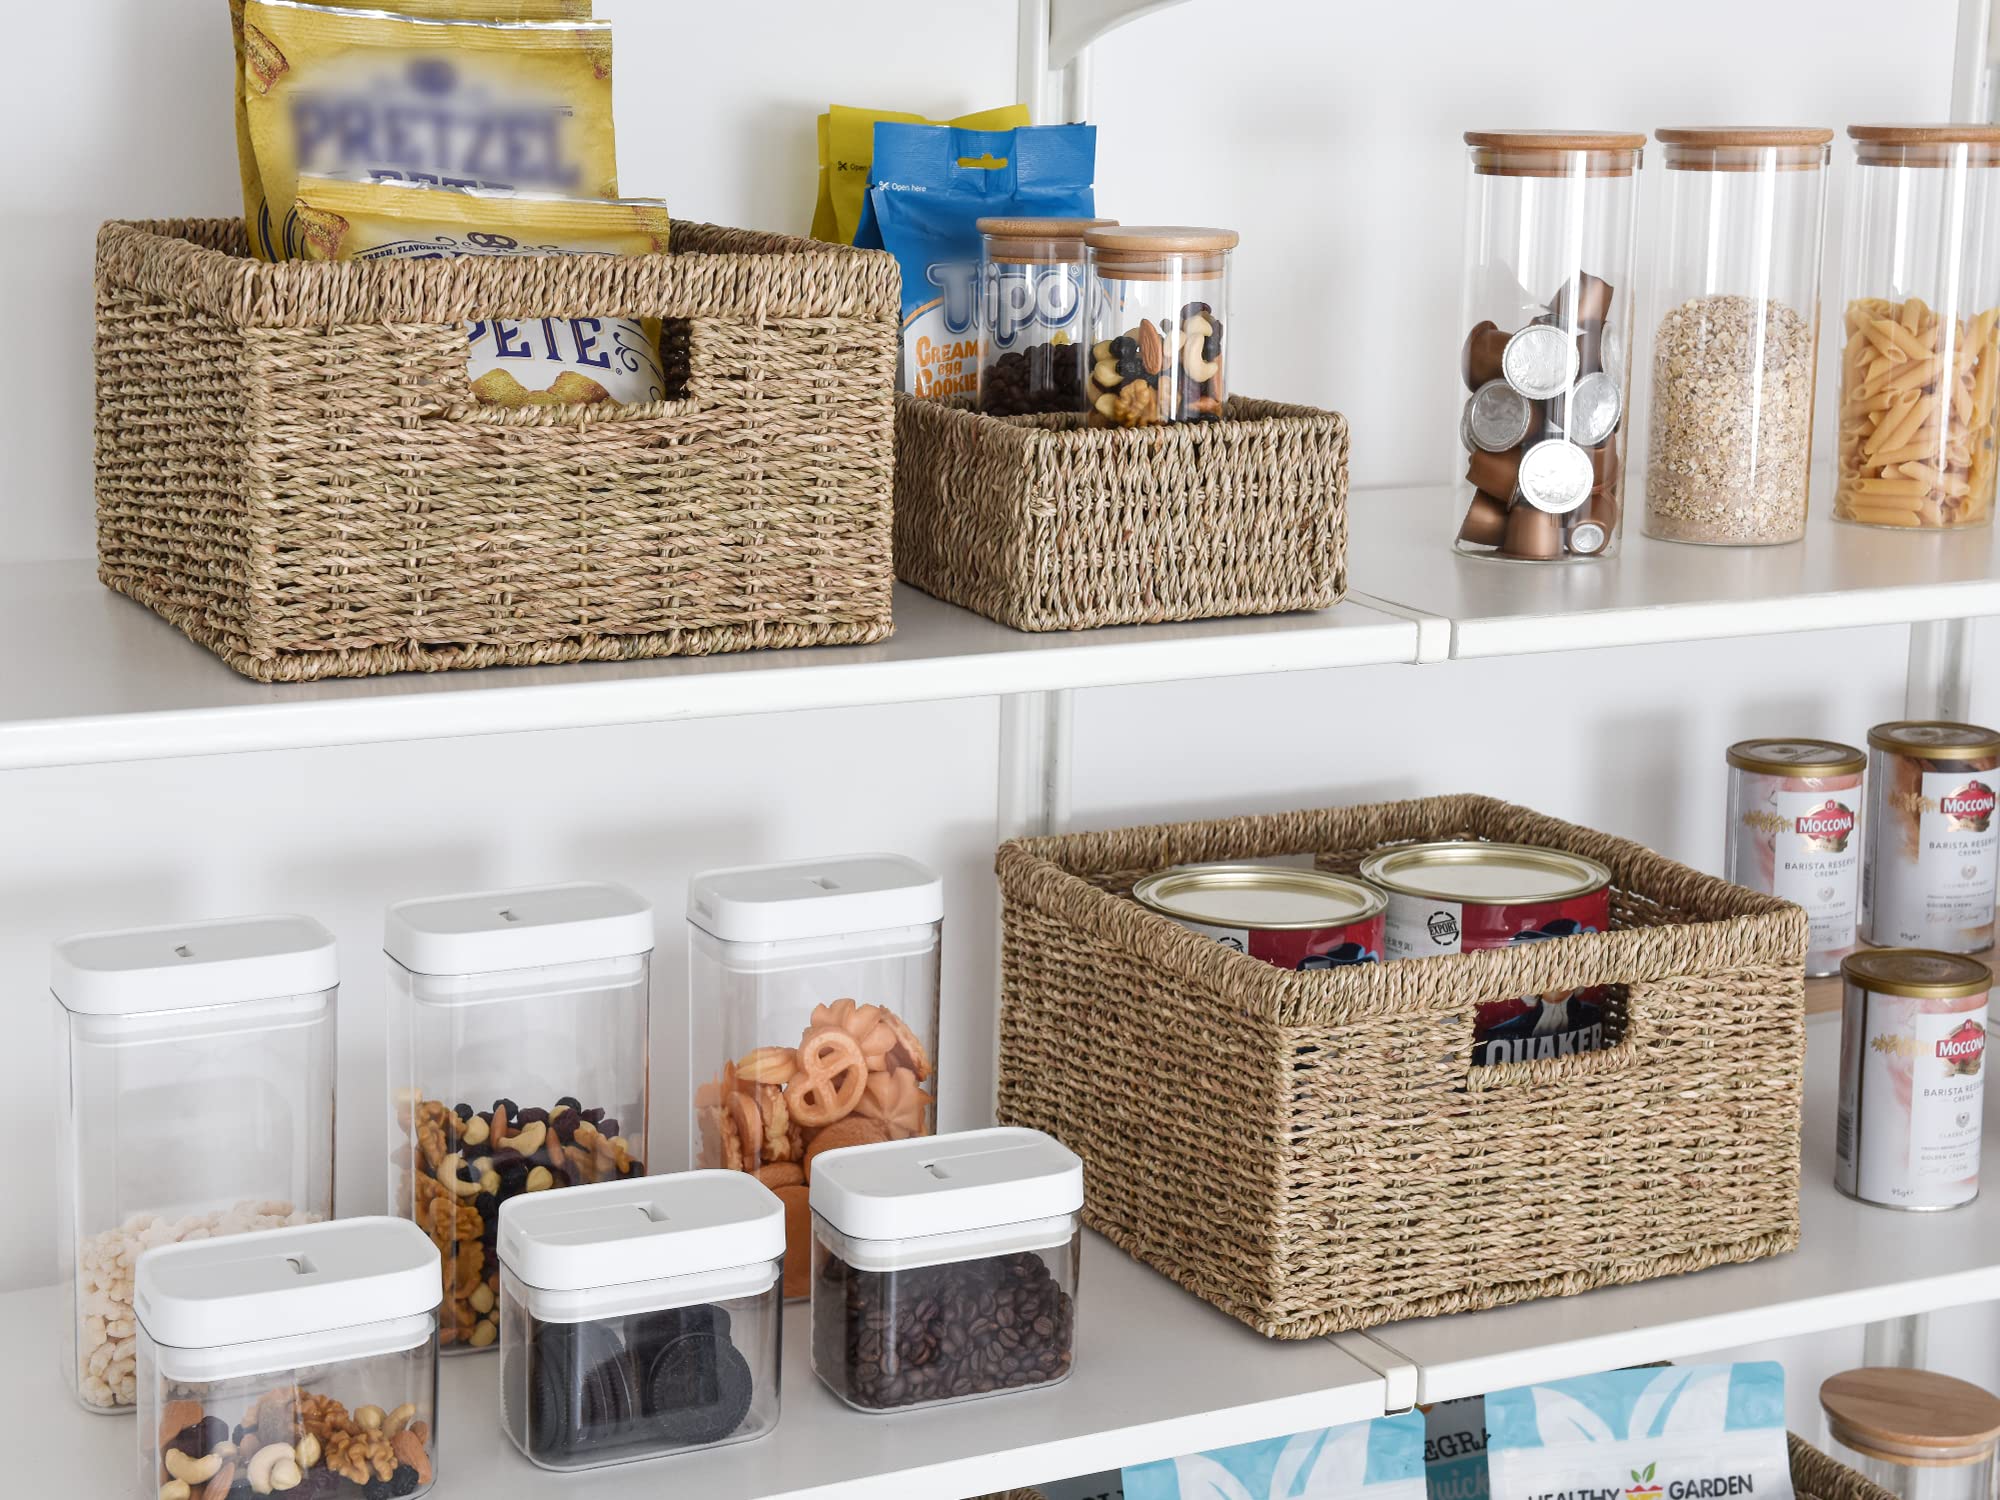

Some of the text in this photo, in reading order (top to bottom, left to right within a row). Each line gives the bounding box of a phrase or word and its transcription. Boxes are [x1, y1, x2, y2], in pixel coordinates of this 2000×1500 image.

[891, 182, 927, 192] Open here
[926, 262, 1081, 349] Tipo
[1799, 815, 1852, 834] MOCCONA
[1928, 840, 1968, 850] BARISTA
[1784, 860, 1826, 871] BARISTA
[1428, 920, 1458, 936] EXPORT
[1923, 1086, 1963, 1097] BARISTA
[1668, 1474, 1754, 1500] GARDEN
